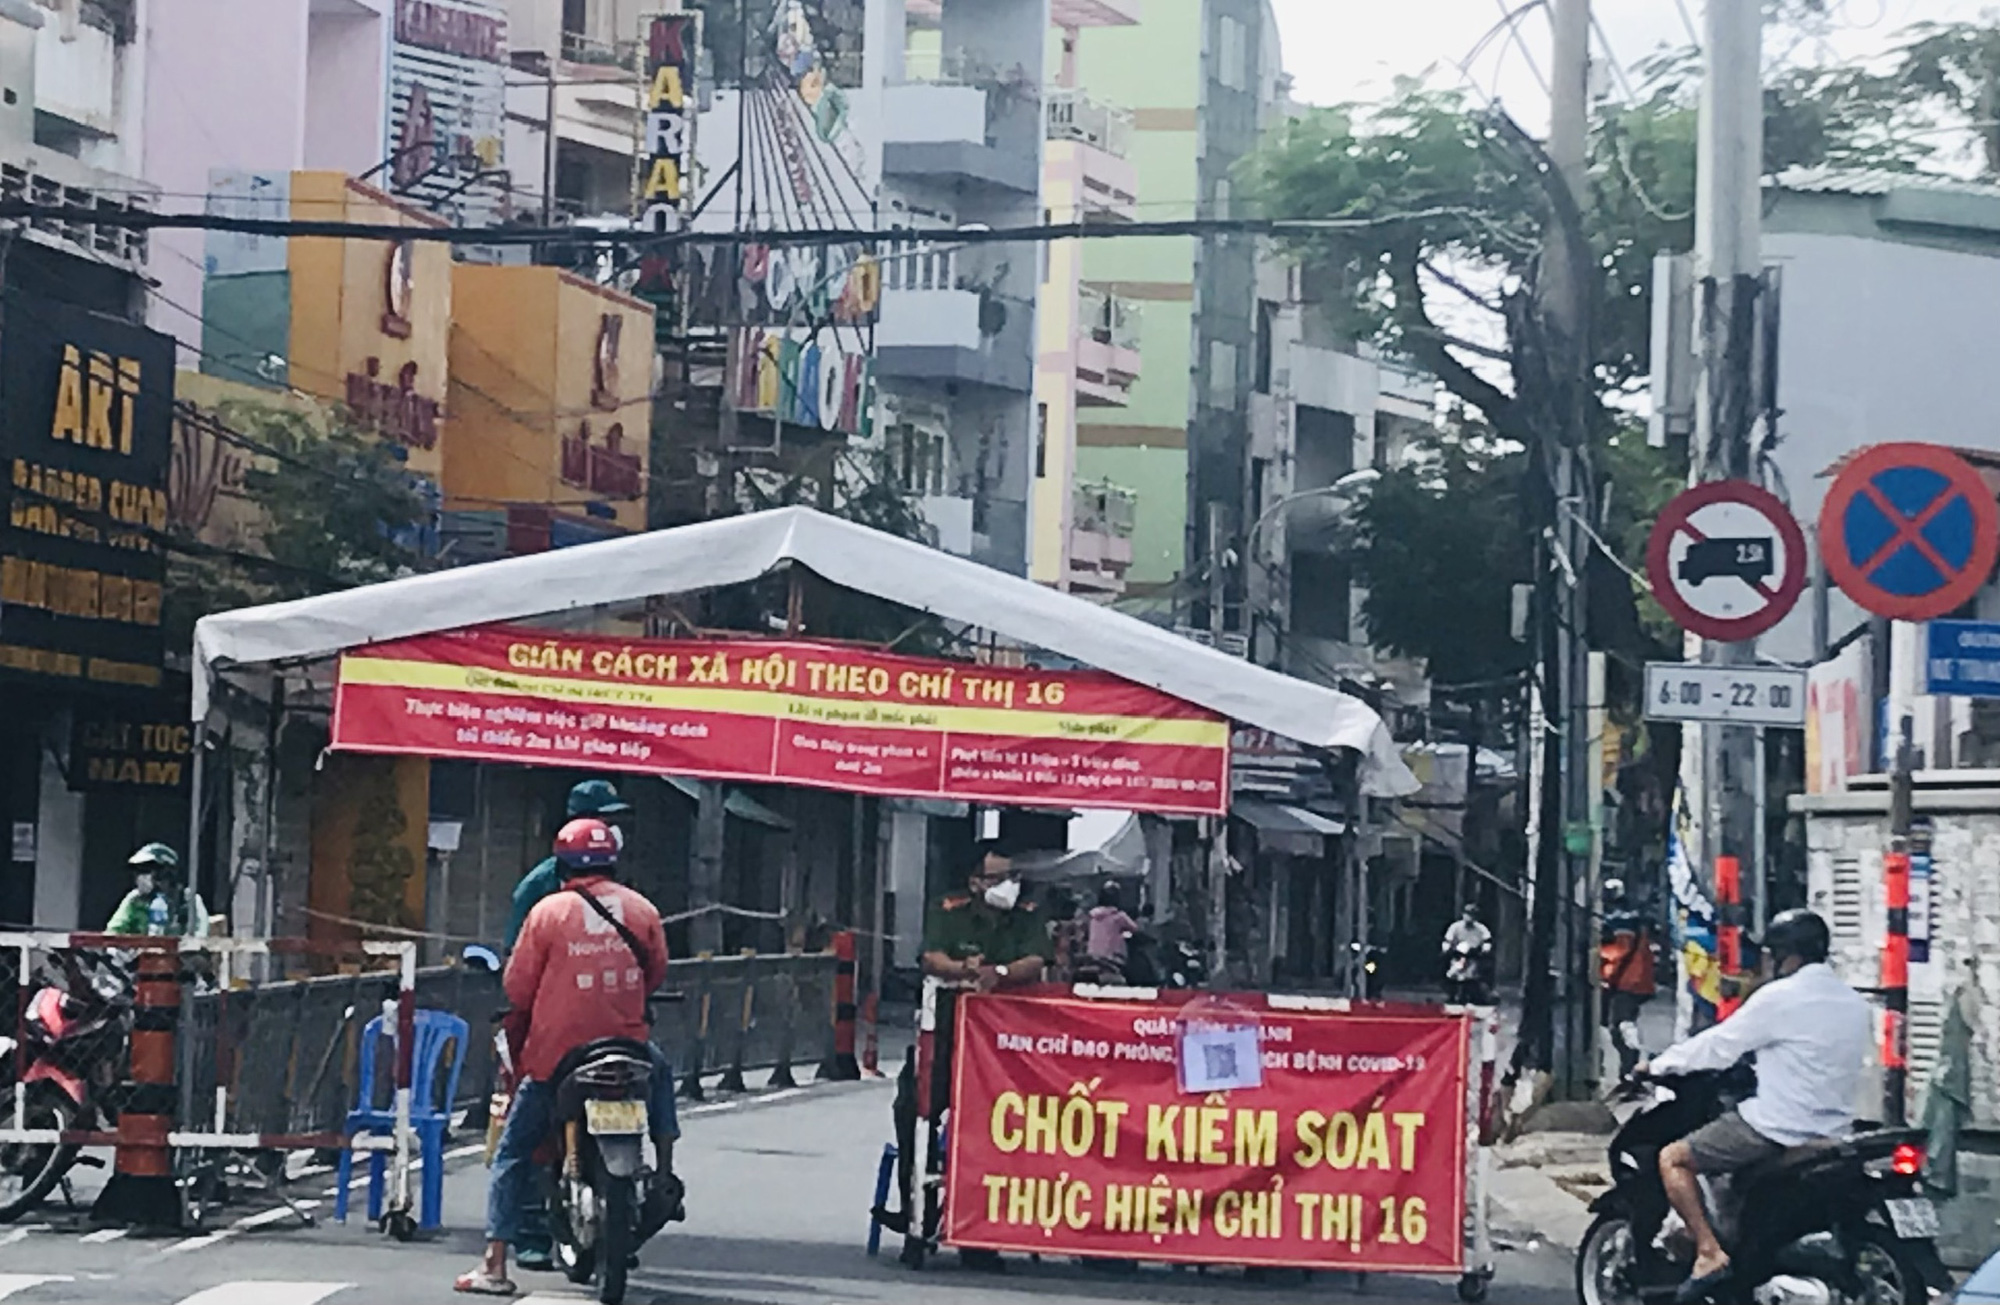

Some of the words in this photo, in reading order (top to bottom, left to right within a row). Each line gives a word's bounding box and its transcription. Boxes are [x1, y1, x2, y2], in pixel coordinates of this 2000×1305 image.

[508, 640, 583, 673] GIÃN
[592, 646, 678, 682] CÁCH
[687, 652, 729, 683] XÃ
[741, 653, 796, 690] HỘI
[806, 660, 890, 696] THEO
[899, 667, 955, 699] CHỈ
[962, 677, 1015, 708] THỊ
[1026, 682, 1066, 705] 16
[525, 732, 551, 750] 2m
[997, 1033, 1032, 1053] BAN
[1036, 1034, 1069, 1055] CHỈ
[1292, 1049, 1343, 1073] BỆNH
[1347, 1053, 1426, 1072] COVID-19
[990, 1077, 1128, 1157] CHỐT
[1295, 1096, 1425, 1172] SOÁT
[982, 1172, 1092, 1237] THỰC
[1104, 1175, 1203, 1243] HIỆN
[1214, 1175, 1285, 1239] CHỈ
[1295, 1192, 1363, 1252] THỊ
[1378, 1197, 1428, 1245] 16
